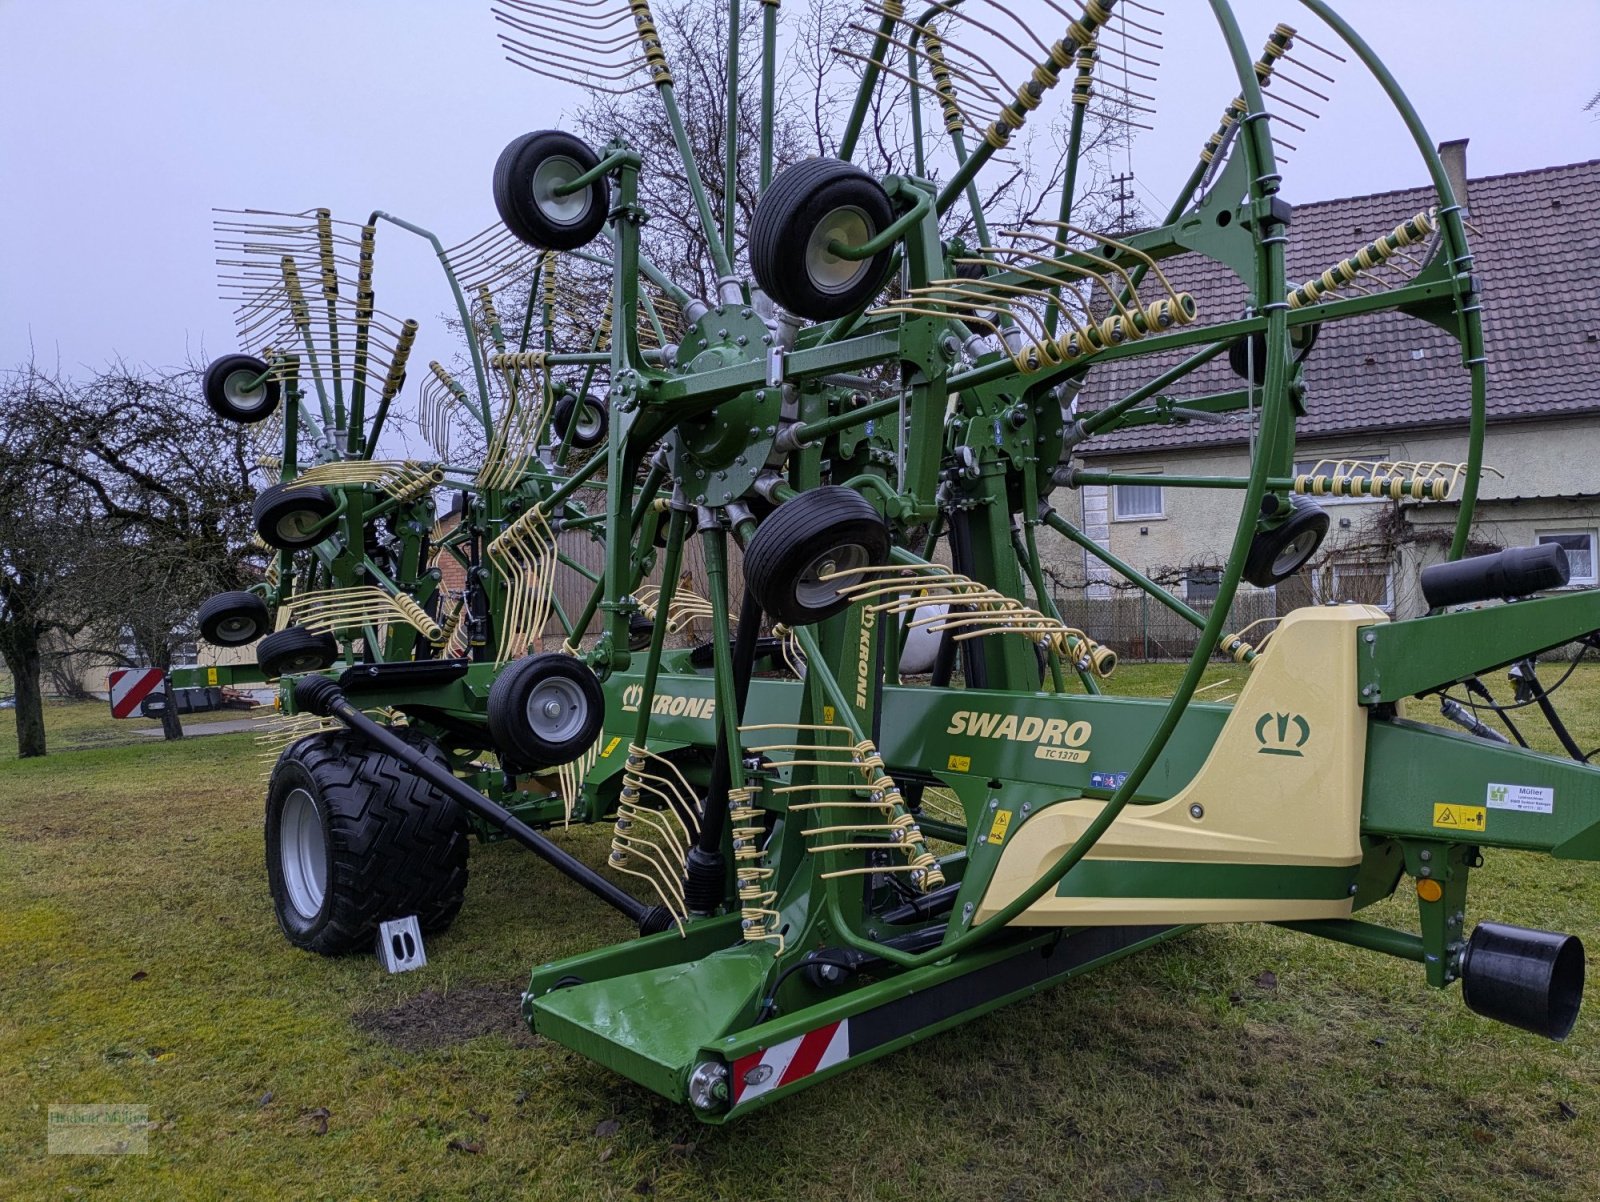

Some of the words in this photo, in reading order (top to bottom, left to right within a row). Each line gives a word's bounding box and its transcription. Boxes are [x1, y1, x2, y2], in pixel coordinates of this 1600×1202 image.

[856, 628, 871, 710] KRONE
[946, 710, 1093, 748] SWADRO
[1044, 749, 1057, 758] TC
[1058, 750, 1079, 761] 1370
[1519, 788, 1543, 796] Müller
